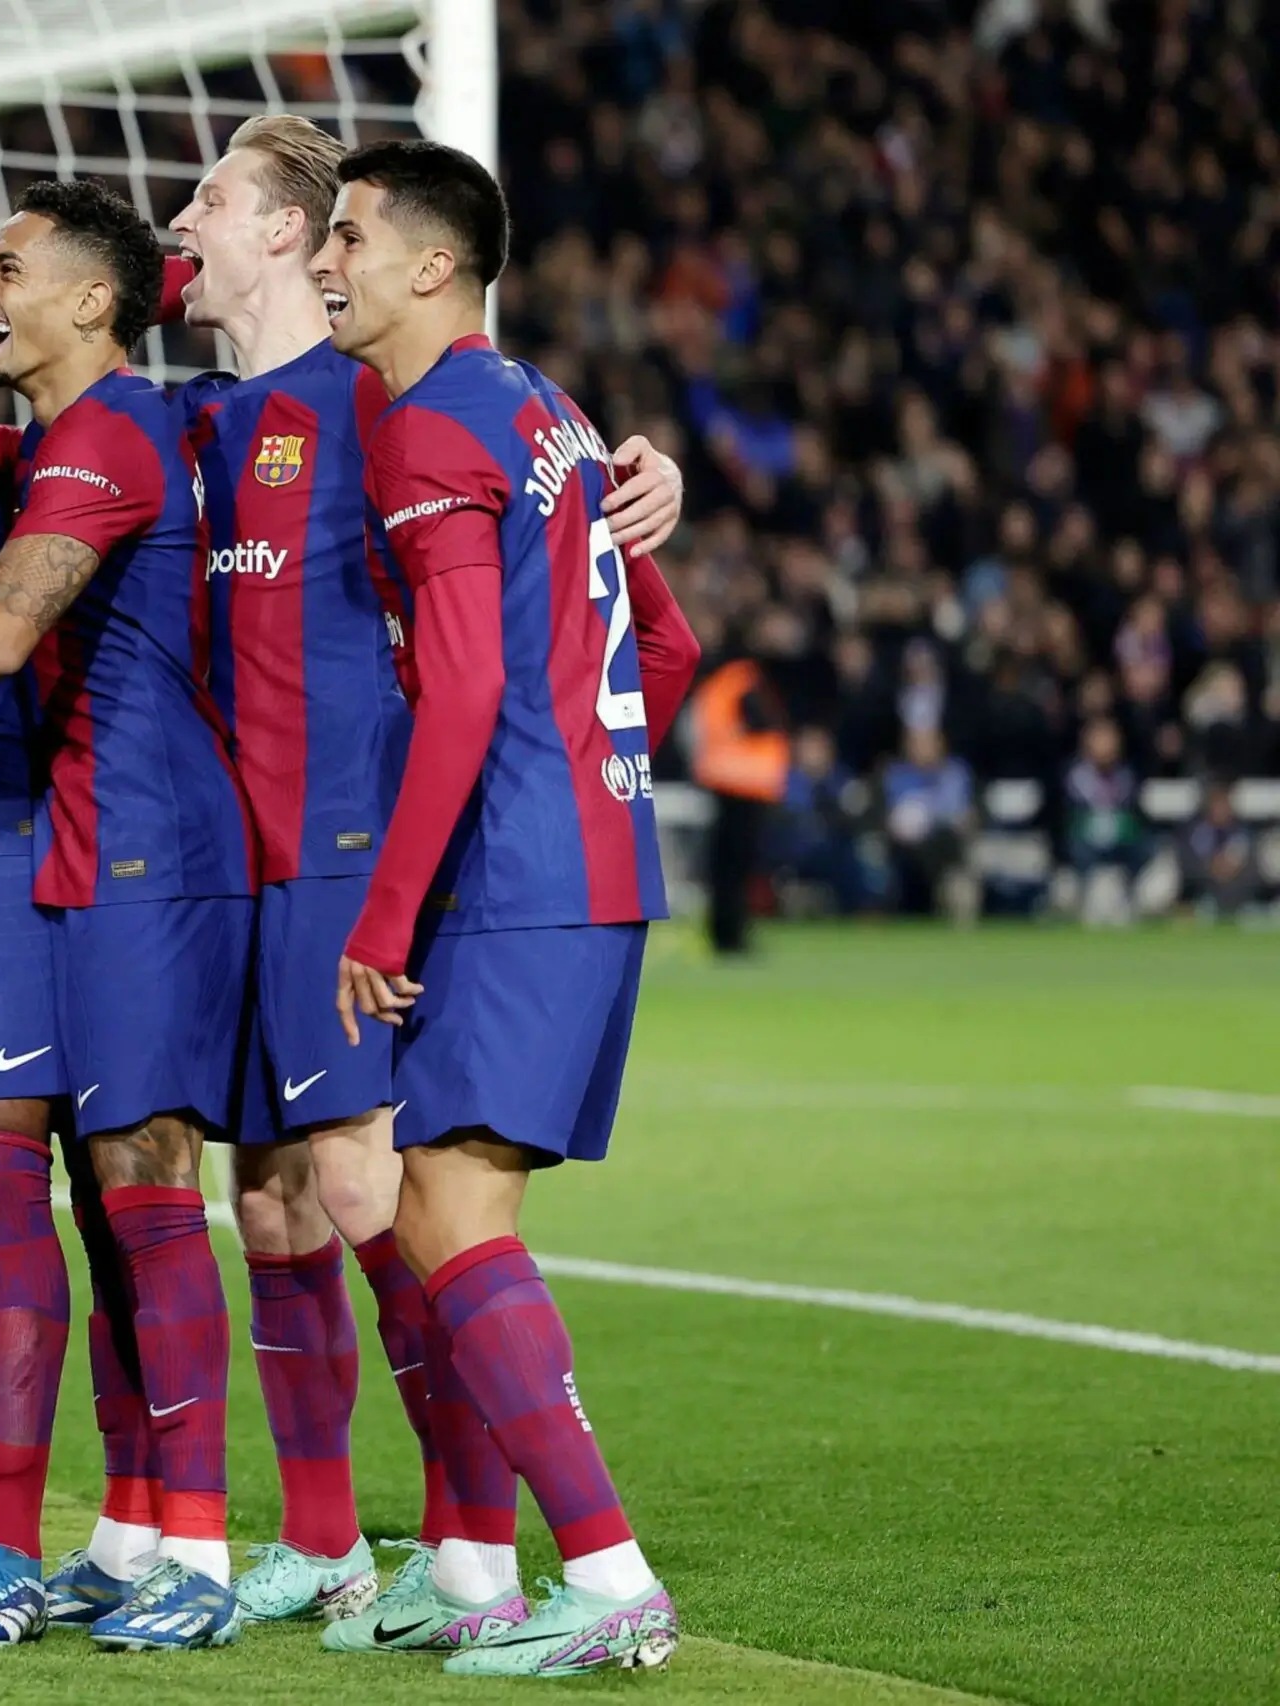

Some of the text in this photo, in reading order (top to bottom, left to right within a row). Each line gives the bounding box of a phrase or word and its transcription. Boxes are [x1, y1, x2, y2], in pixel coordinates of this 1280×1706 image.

[33, 466, 122, 497] AMBILIGHT tv
[384, 497, 453, 532] AMBILIGHT
[206, 539, 288, 581] potify
[588, 518, 648, 731] 2
